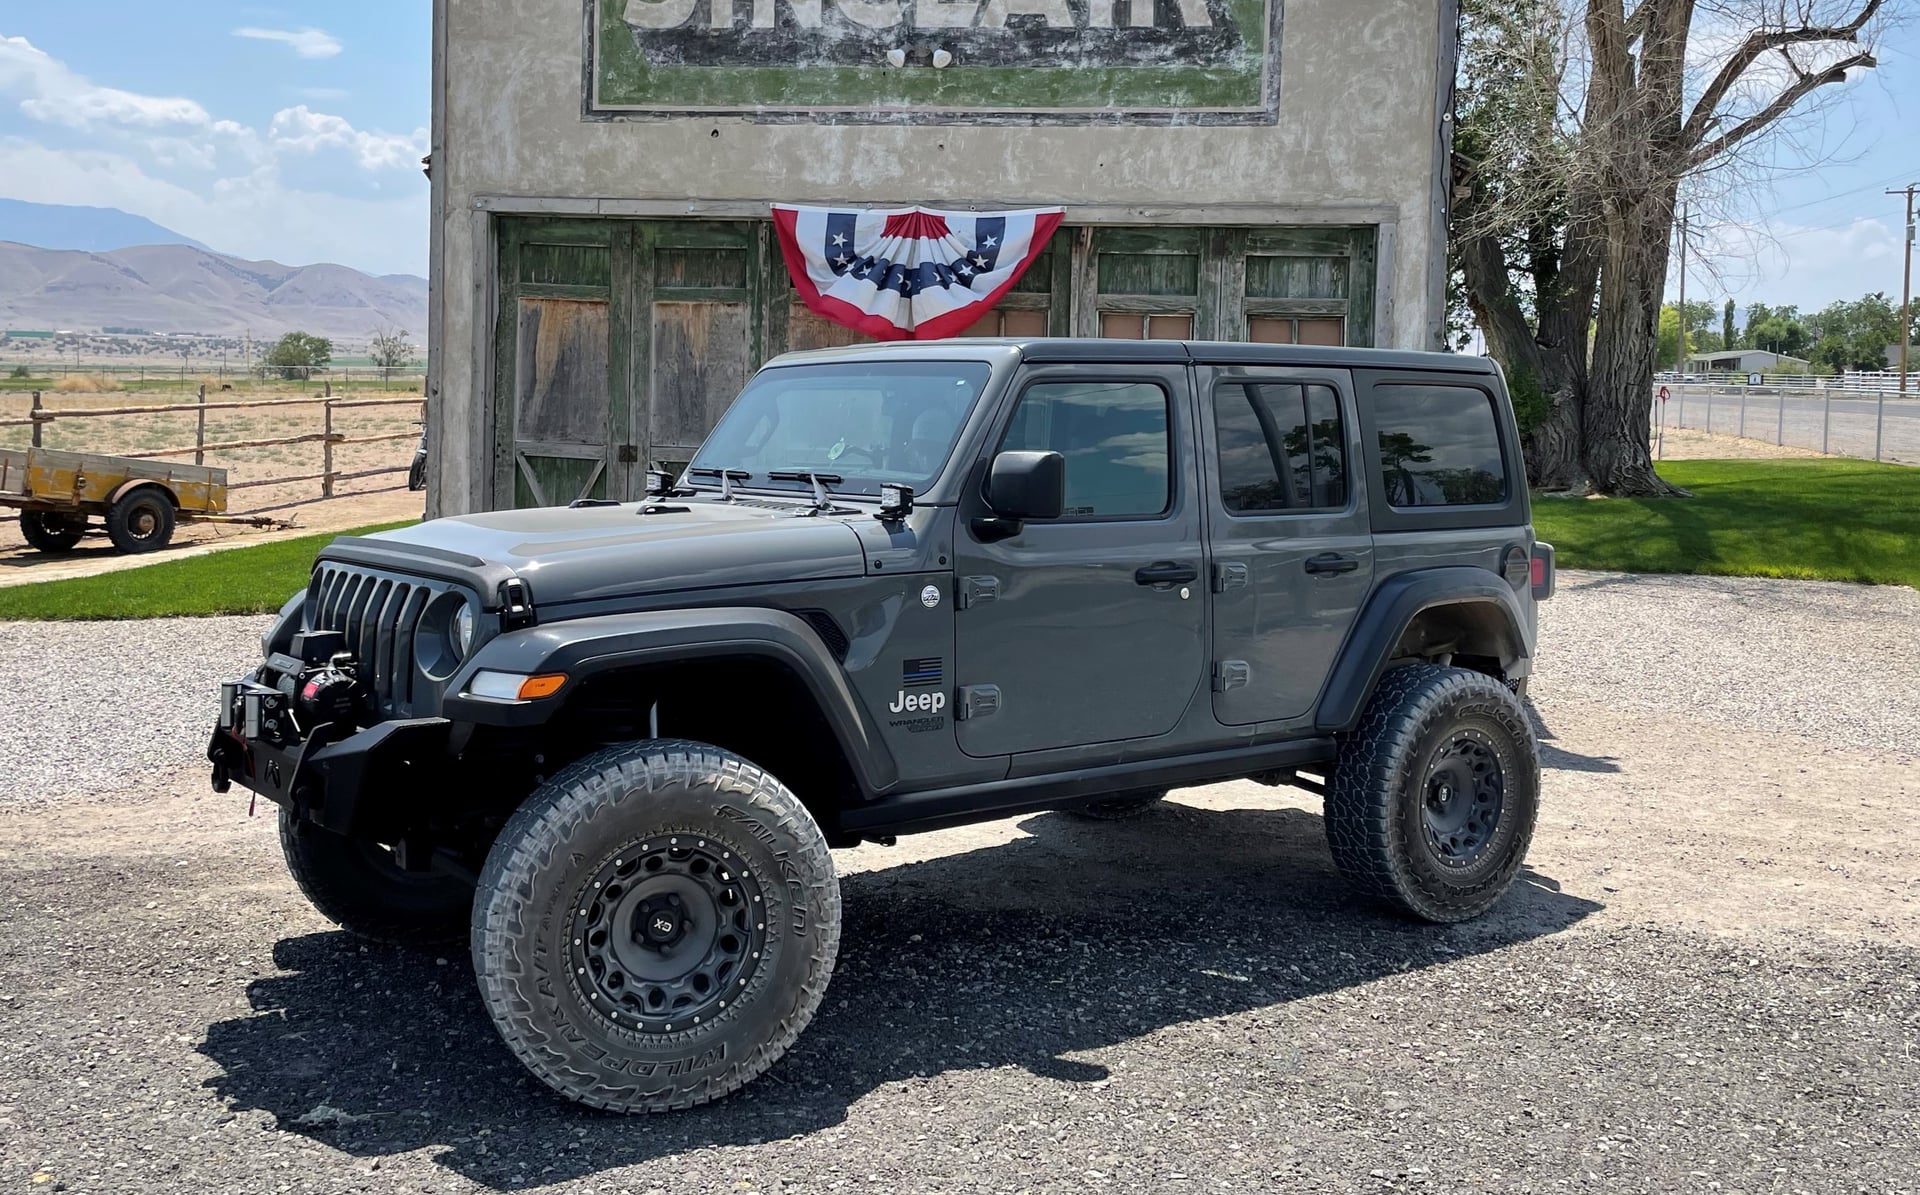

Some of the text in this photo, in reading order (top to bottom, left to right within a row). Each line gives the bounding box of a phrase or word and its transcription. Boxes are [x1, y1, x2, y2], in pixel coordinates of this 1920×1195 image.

[889, 690, 946, 714] Jeep
[710, 803, 808, 937] FALKEN
[549, 1003, 728, 1078] WILDPEAK
